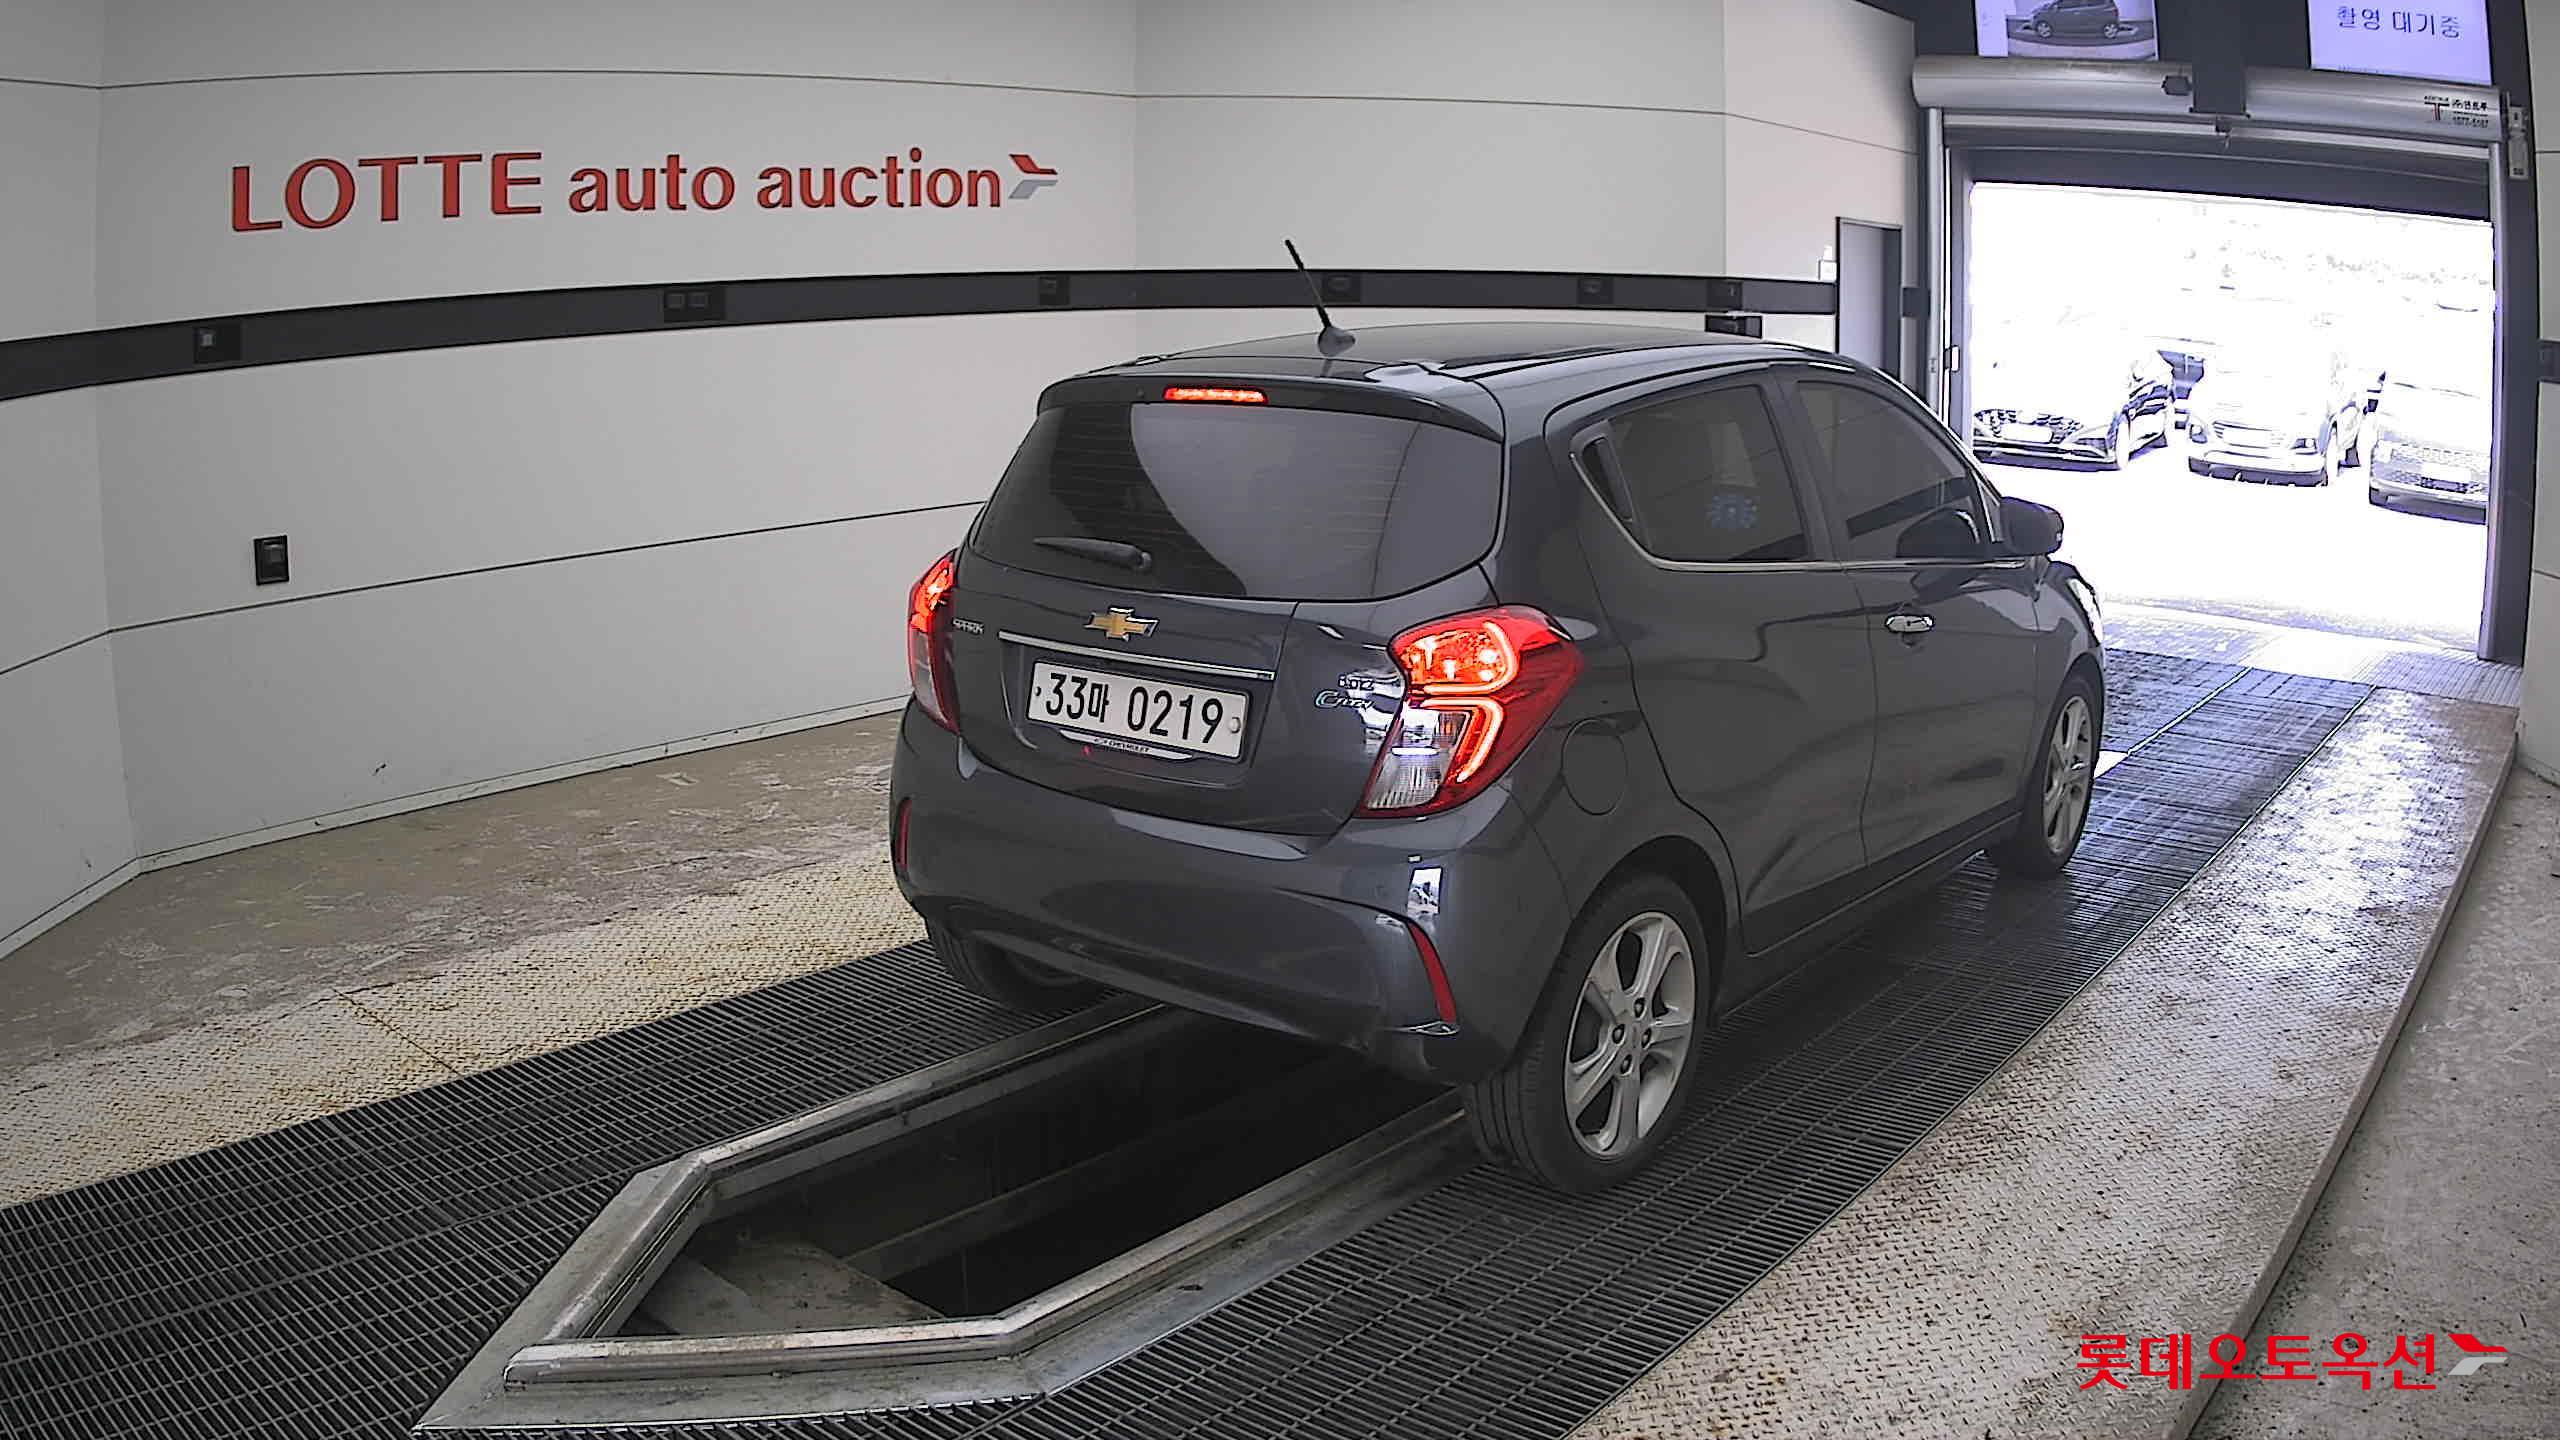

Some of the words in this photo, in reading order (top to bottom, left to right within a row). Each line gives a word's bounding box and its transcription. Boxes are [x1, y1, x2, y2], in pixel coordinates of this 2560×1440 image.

[2338, 6, 2381, 31] 촬영
[2392, 11, 2460, 39] 대기중
[232, 152, 542, 231] LOTTE
[568, 154, 735, 212] auto
[757, 147, 1002, 210] auction
[1045, 672, 1109, 723] 33마
[1127, 686, 1223, 743] 0219
